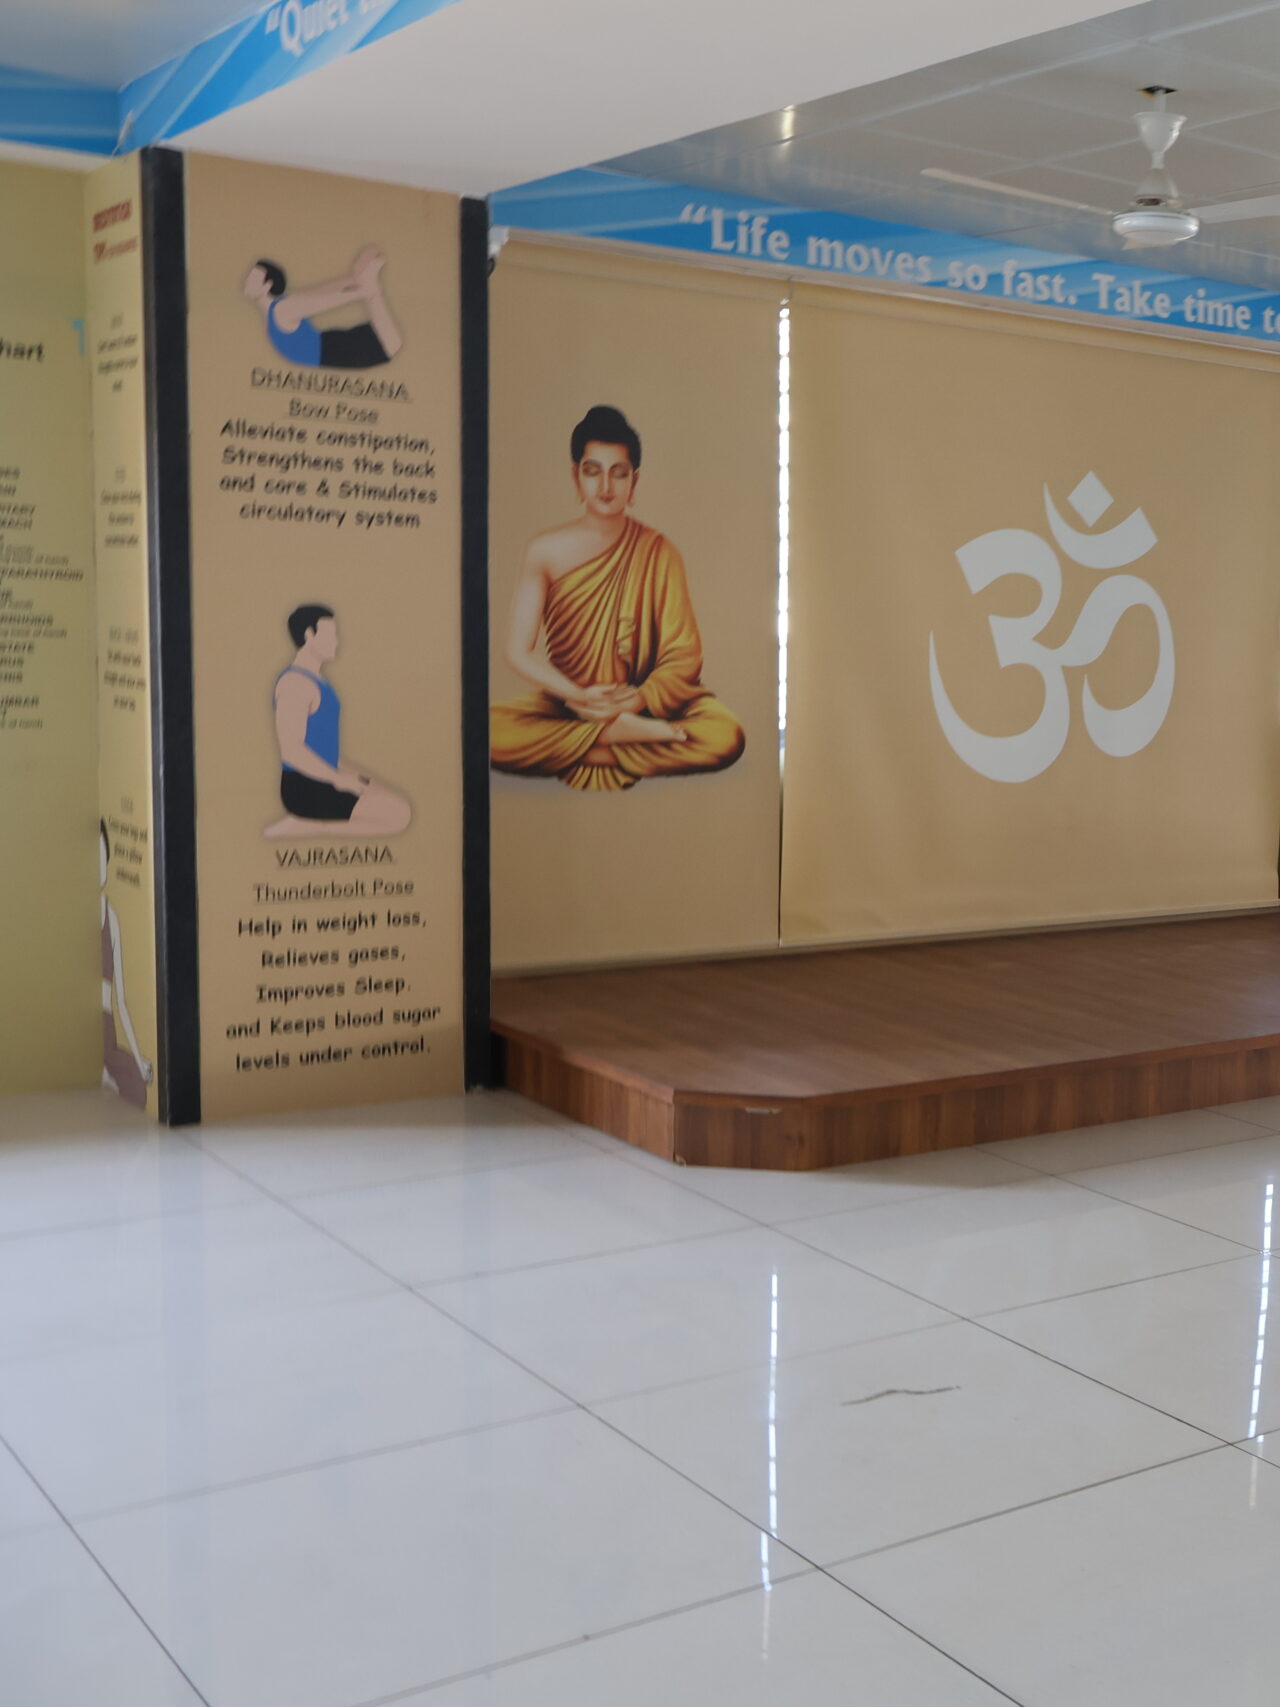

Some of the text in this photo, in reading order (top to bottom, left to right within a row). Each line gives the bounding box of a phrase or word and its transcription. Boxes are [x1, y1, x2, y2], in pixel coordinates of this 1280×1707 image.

[807, 235, 933, 283] moves
[948, 260, 988, 291] so
[1002, 259, 1078, 305] fast.
[1092, 273, 1171, 319] Take
[1184, 288, 1252, 331] time
[251, 367, 410, 400] DHANURASANA
[289, 397, 380, 423] Bow Pose
[220, 418, 436, 456] Alleviate constipation,
[221, 445, 436, 478] Strengthens the back
[219, 474, 438, 505] and core & Stimulates
[239, 501, 421, 530] circulatory system
[276, 845, 394, 868] VAJRASANA
[253, 877, 415, 903] Thunderbolt Pose
[238, 909, 427, 939] Help in weight loss,
[261, 945, 406, 968] Relieves gases,
[256, 982, 346, 1005] Improves
[226, 1006, 441, 1039] and Keeps blood sugar
[236, 1050, 290, 1073] levels
[299, 1045, 353, 1066] under
